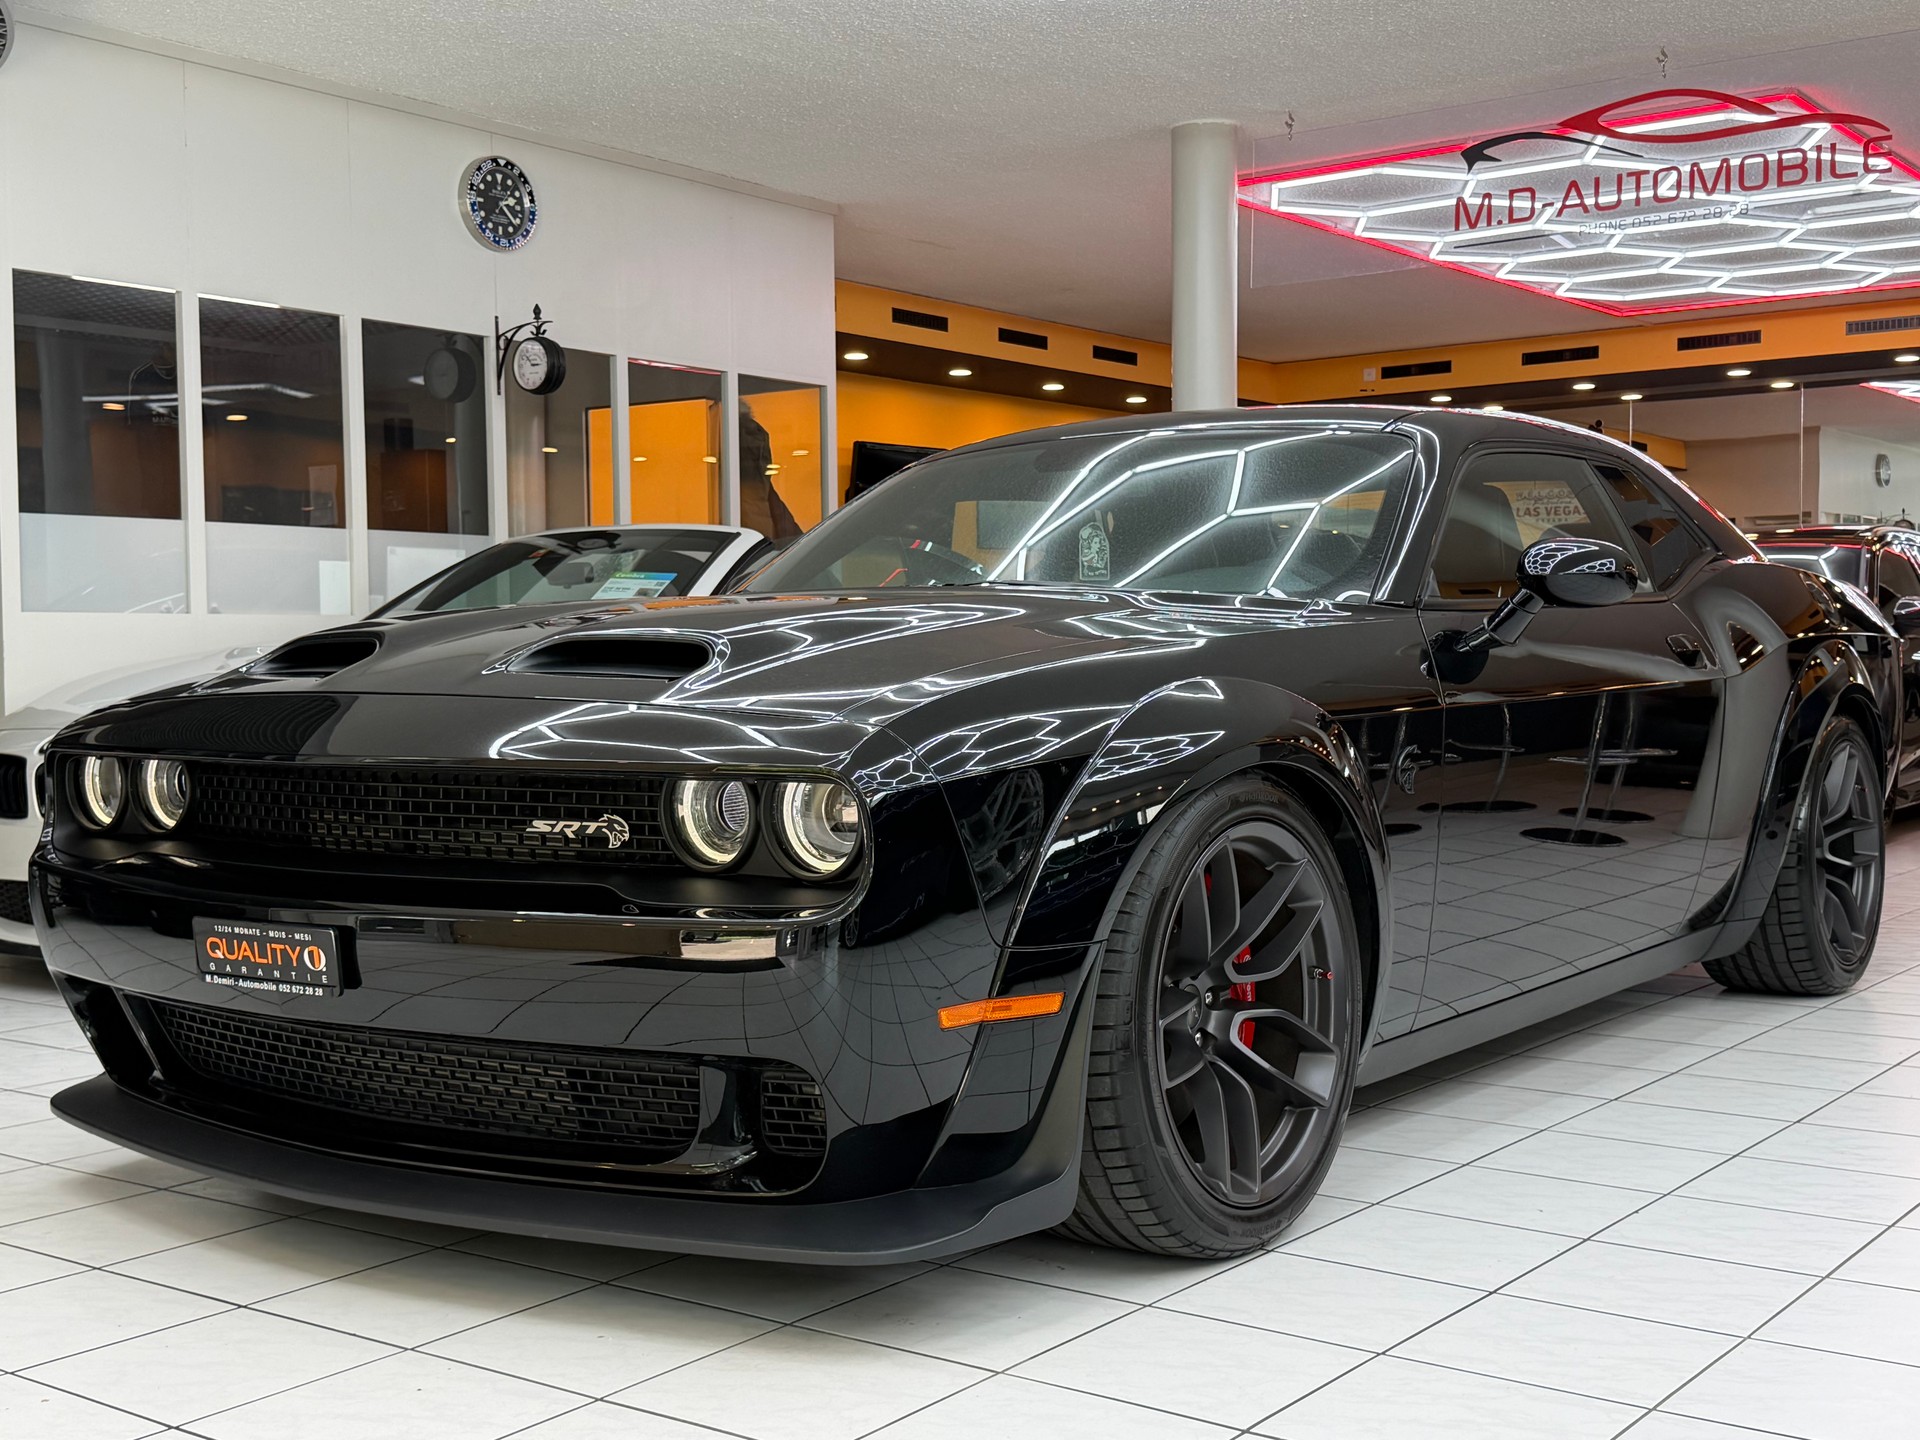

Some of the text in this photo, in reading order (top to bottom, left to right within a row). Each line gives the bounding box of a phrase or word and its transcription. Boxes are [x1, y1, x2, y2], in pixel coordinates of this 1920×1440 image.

[481, 160, 493, 171] 22
[513, 166, 521, 176] 2
[471, 170, 481, 185] 20
[525, 184, 531, 192] 4
[1579, 219, 1627, 236] PHONE
[1632, 215, 1661, 229] 052
[1668, 211, 1697, 224] 672
[1703, 206, 1723, 220] 28
[1516, 506, 1540, 518] LAS
[526, 820, 608, 839] SRT
[214, 925, 232, 933] 12/24
[234, 926, 261, 936] MONATE
[268, 930, 286, 939] MOIS
[294, 933, 312, 942] MESI
[206, 936, 301, 967] QUALITY
[209, 962, 328, 984] GARANTIE
[278, 984, 291, 993] 052
[292, 985, 304, 994] 672
[305, 987, 313, 995] 28
[315, 988, 323, 996] 28
